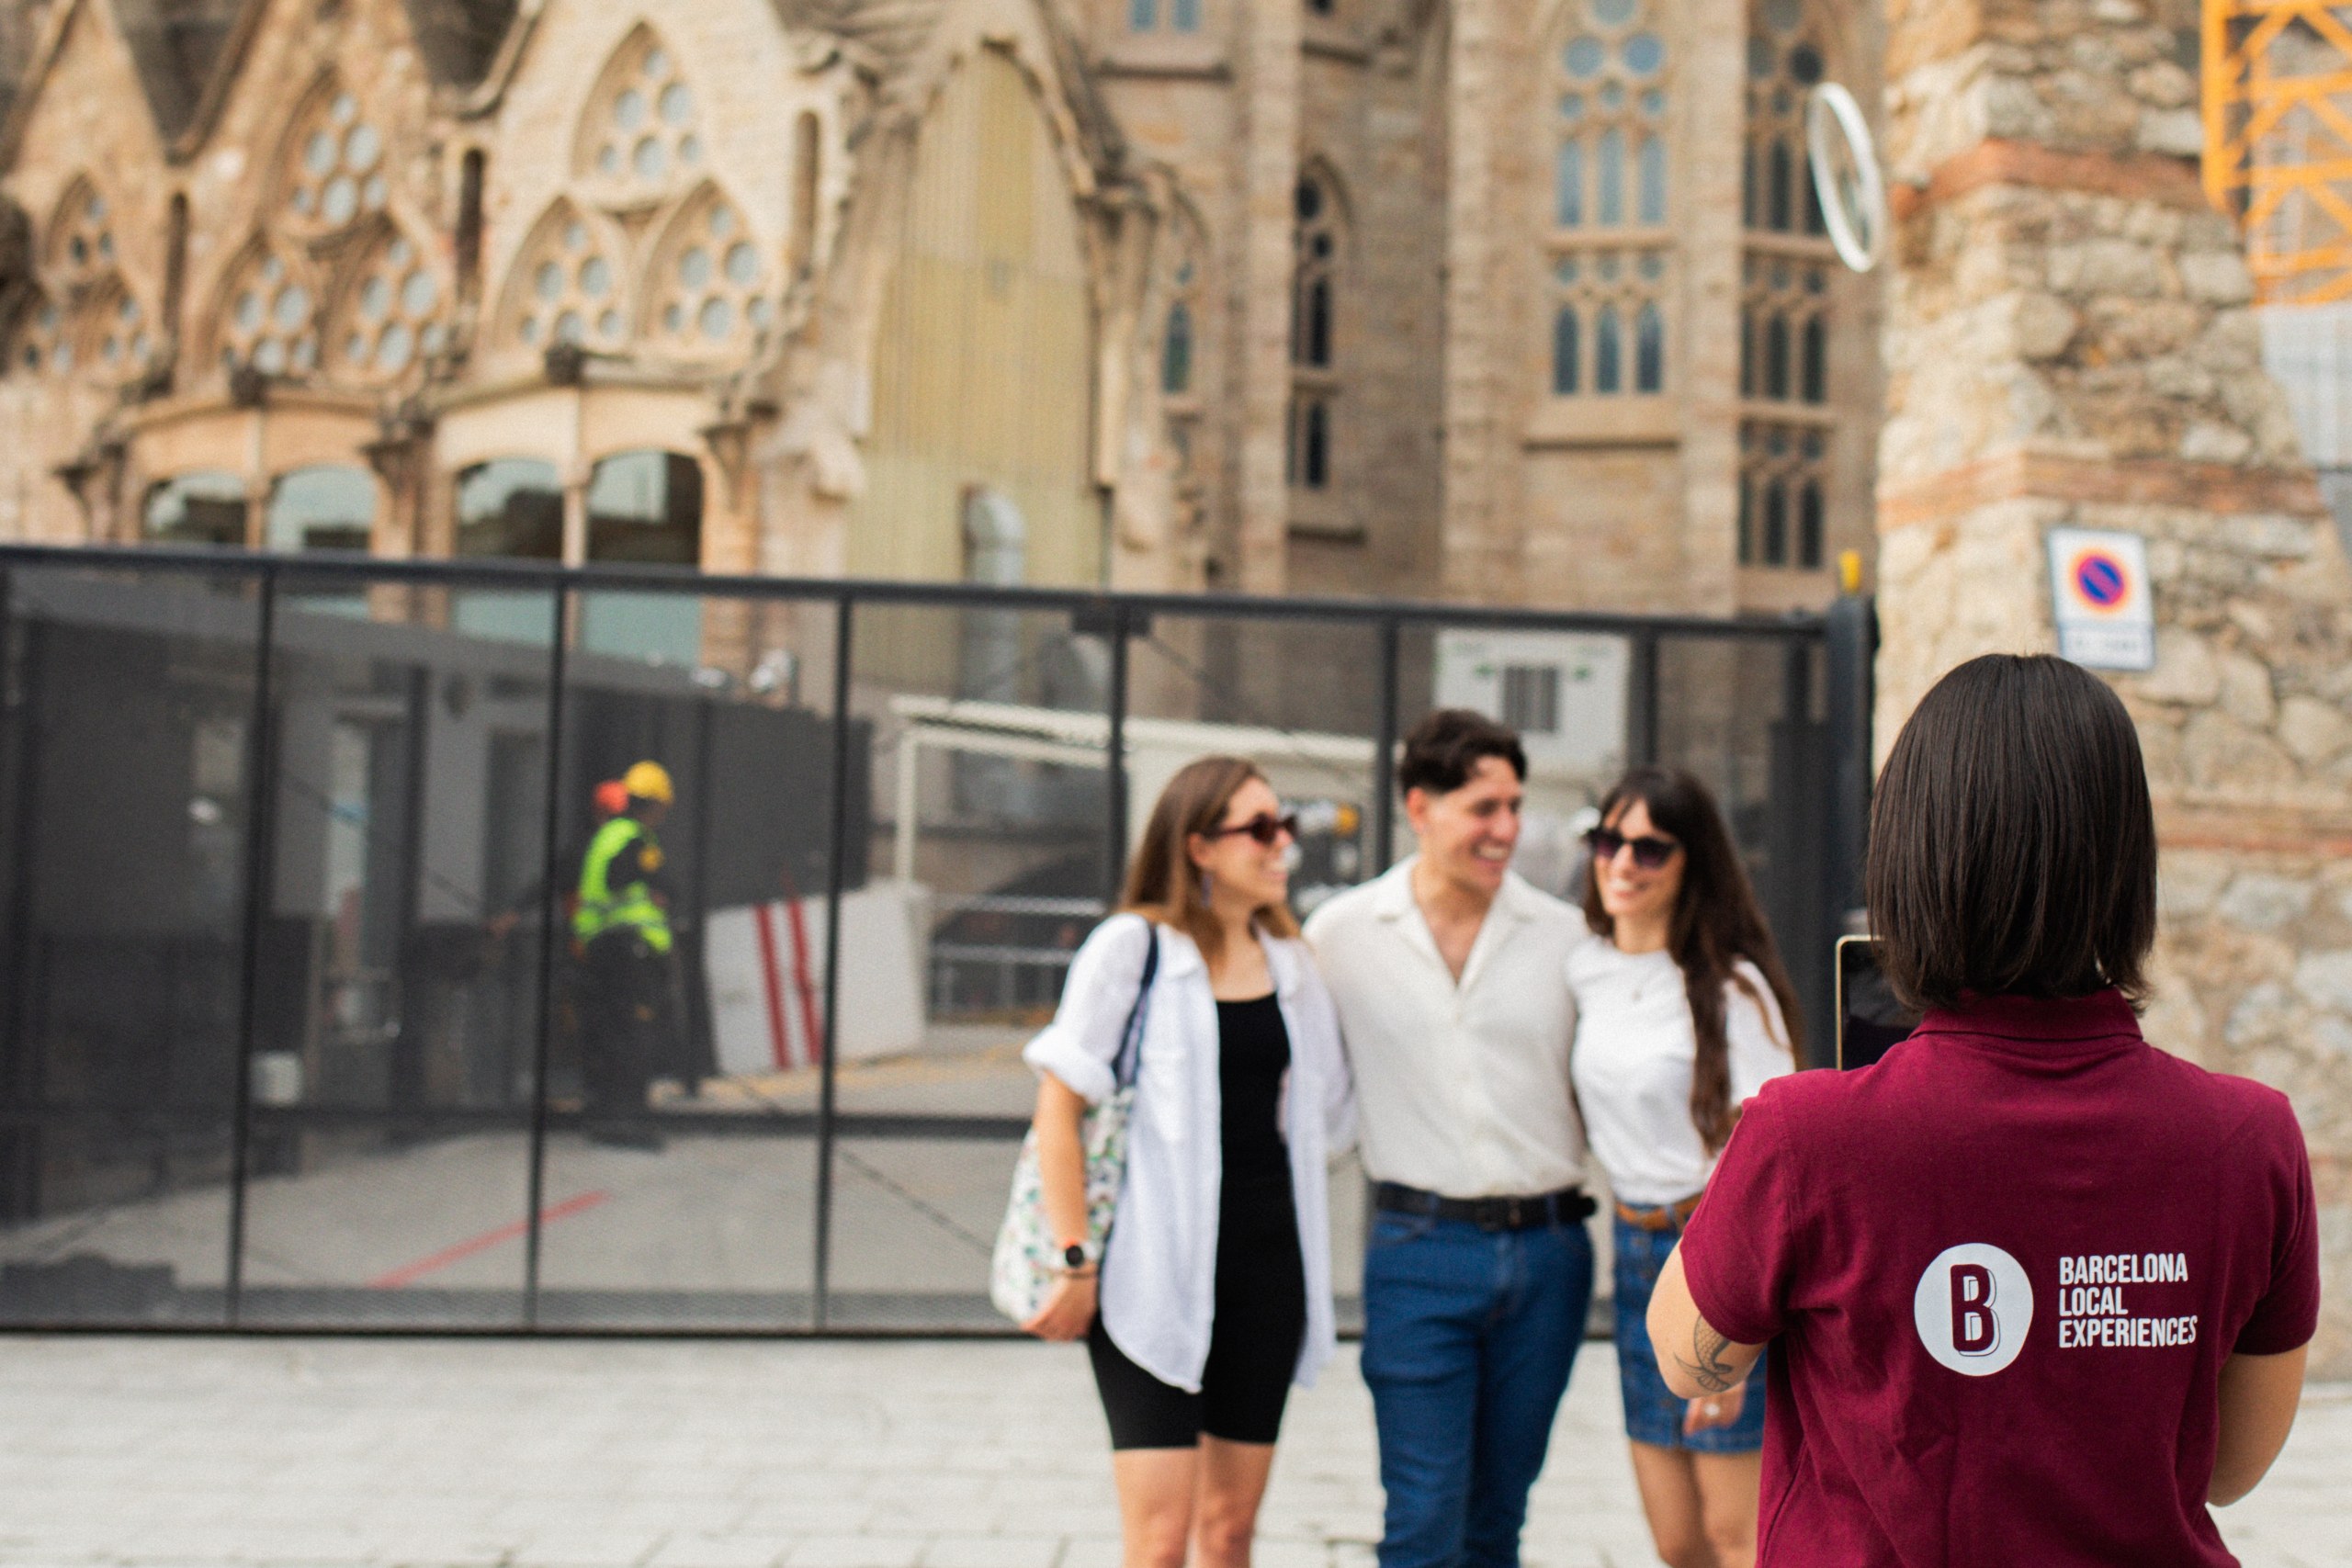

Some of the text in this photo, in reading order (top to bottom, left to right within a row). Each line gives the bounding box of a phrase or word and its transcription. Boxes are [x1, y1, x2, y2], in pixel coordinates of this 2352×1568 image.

[2059, 1253, 2188, 1285] BARCELONA
[1950, 1263, 2000, 1357] B
[2059, 1286, 2129, 1316] LOCAL
[2059, 1315, 2199, 1348] EXPERIENCES
